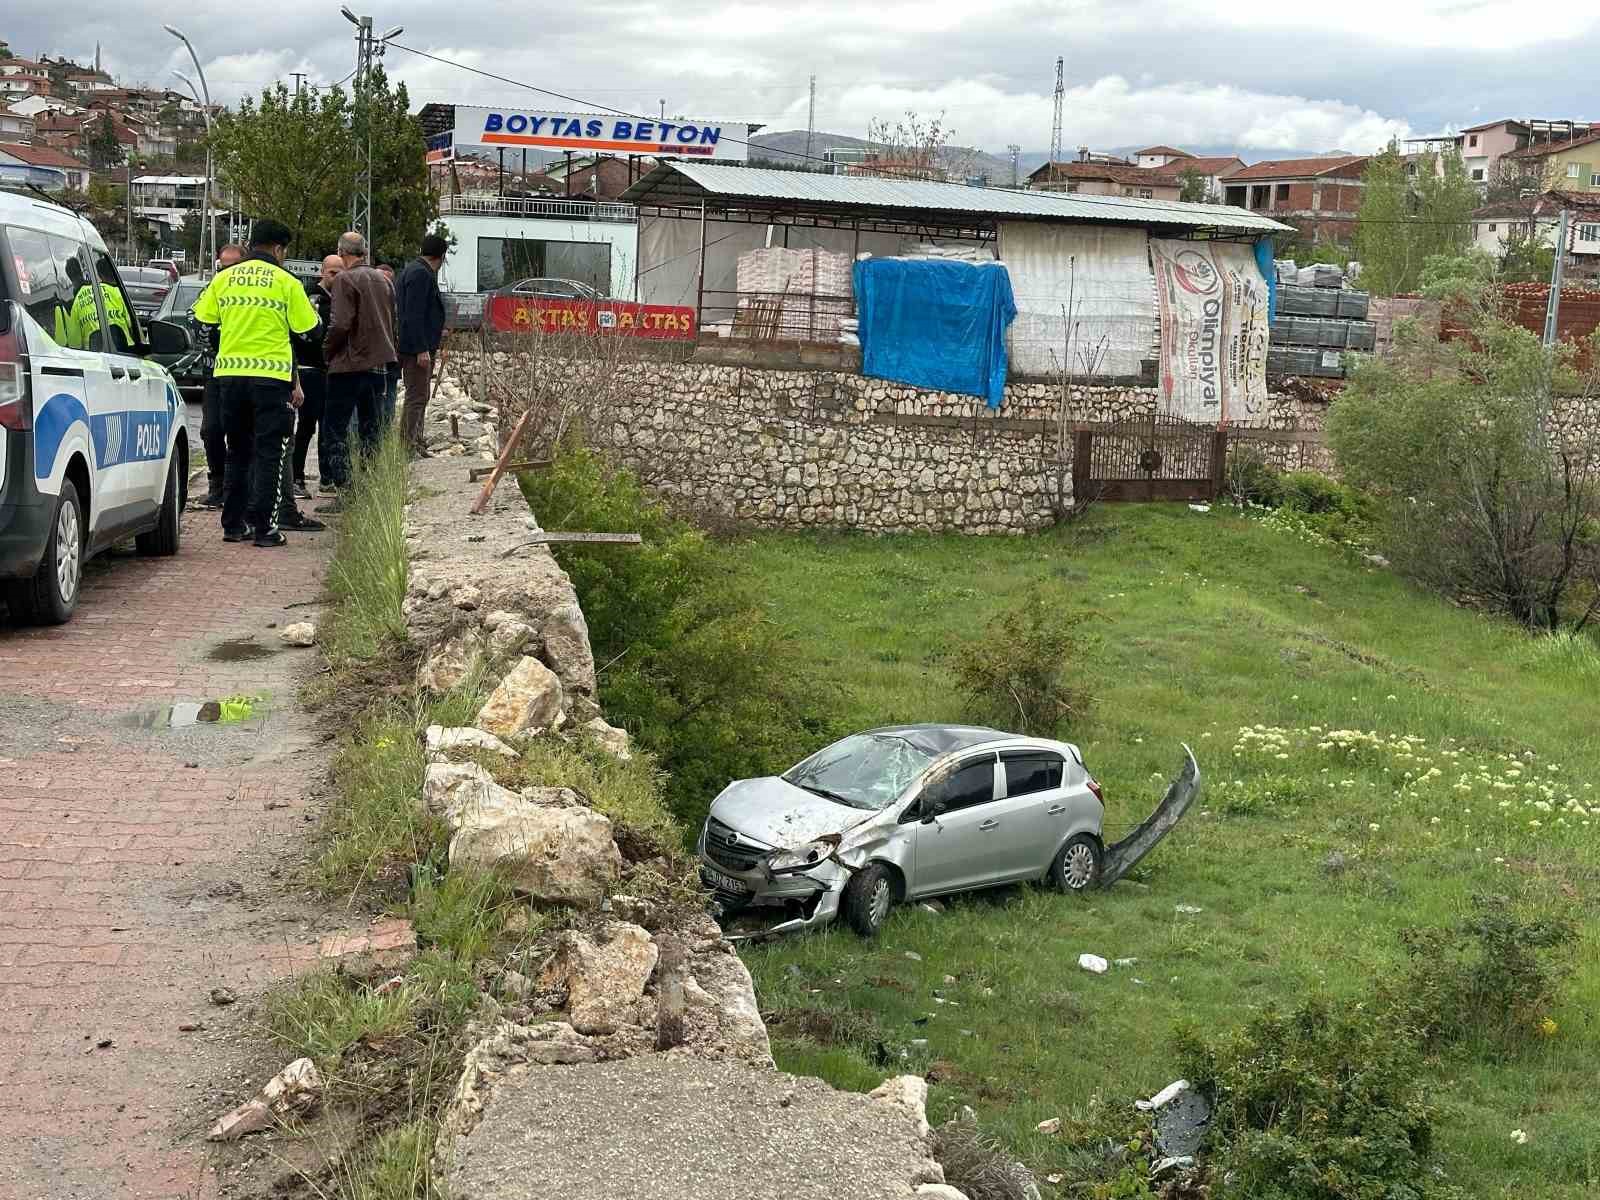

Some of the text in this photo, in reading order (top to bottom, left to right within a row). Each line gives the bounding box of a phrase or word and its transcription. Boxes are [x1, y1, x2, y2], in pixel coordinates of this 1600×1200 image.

[484, 113, 721, 145] BOYTAS BETON
[229, 276, 273, 288] POLİSİ
[232, 266, 275, 277] TRAFİK
[1198, 298, 1220, 408] Olimpiyat
[136, 412, 160, 456] POLİS
